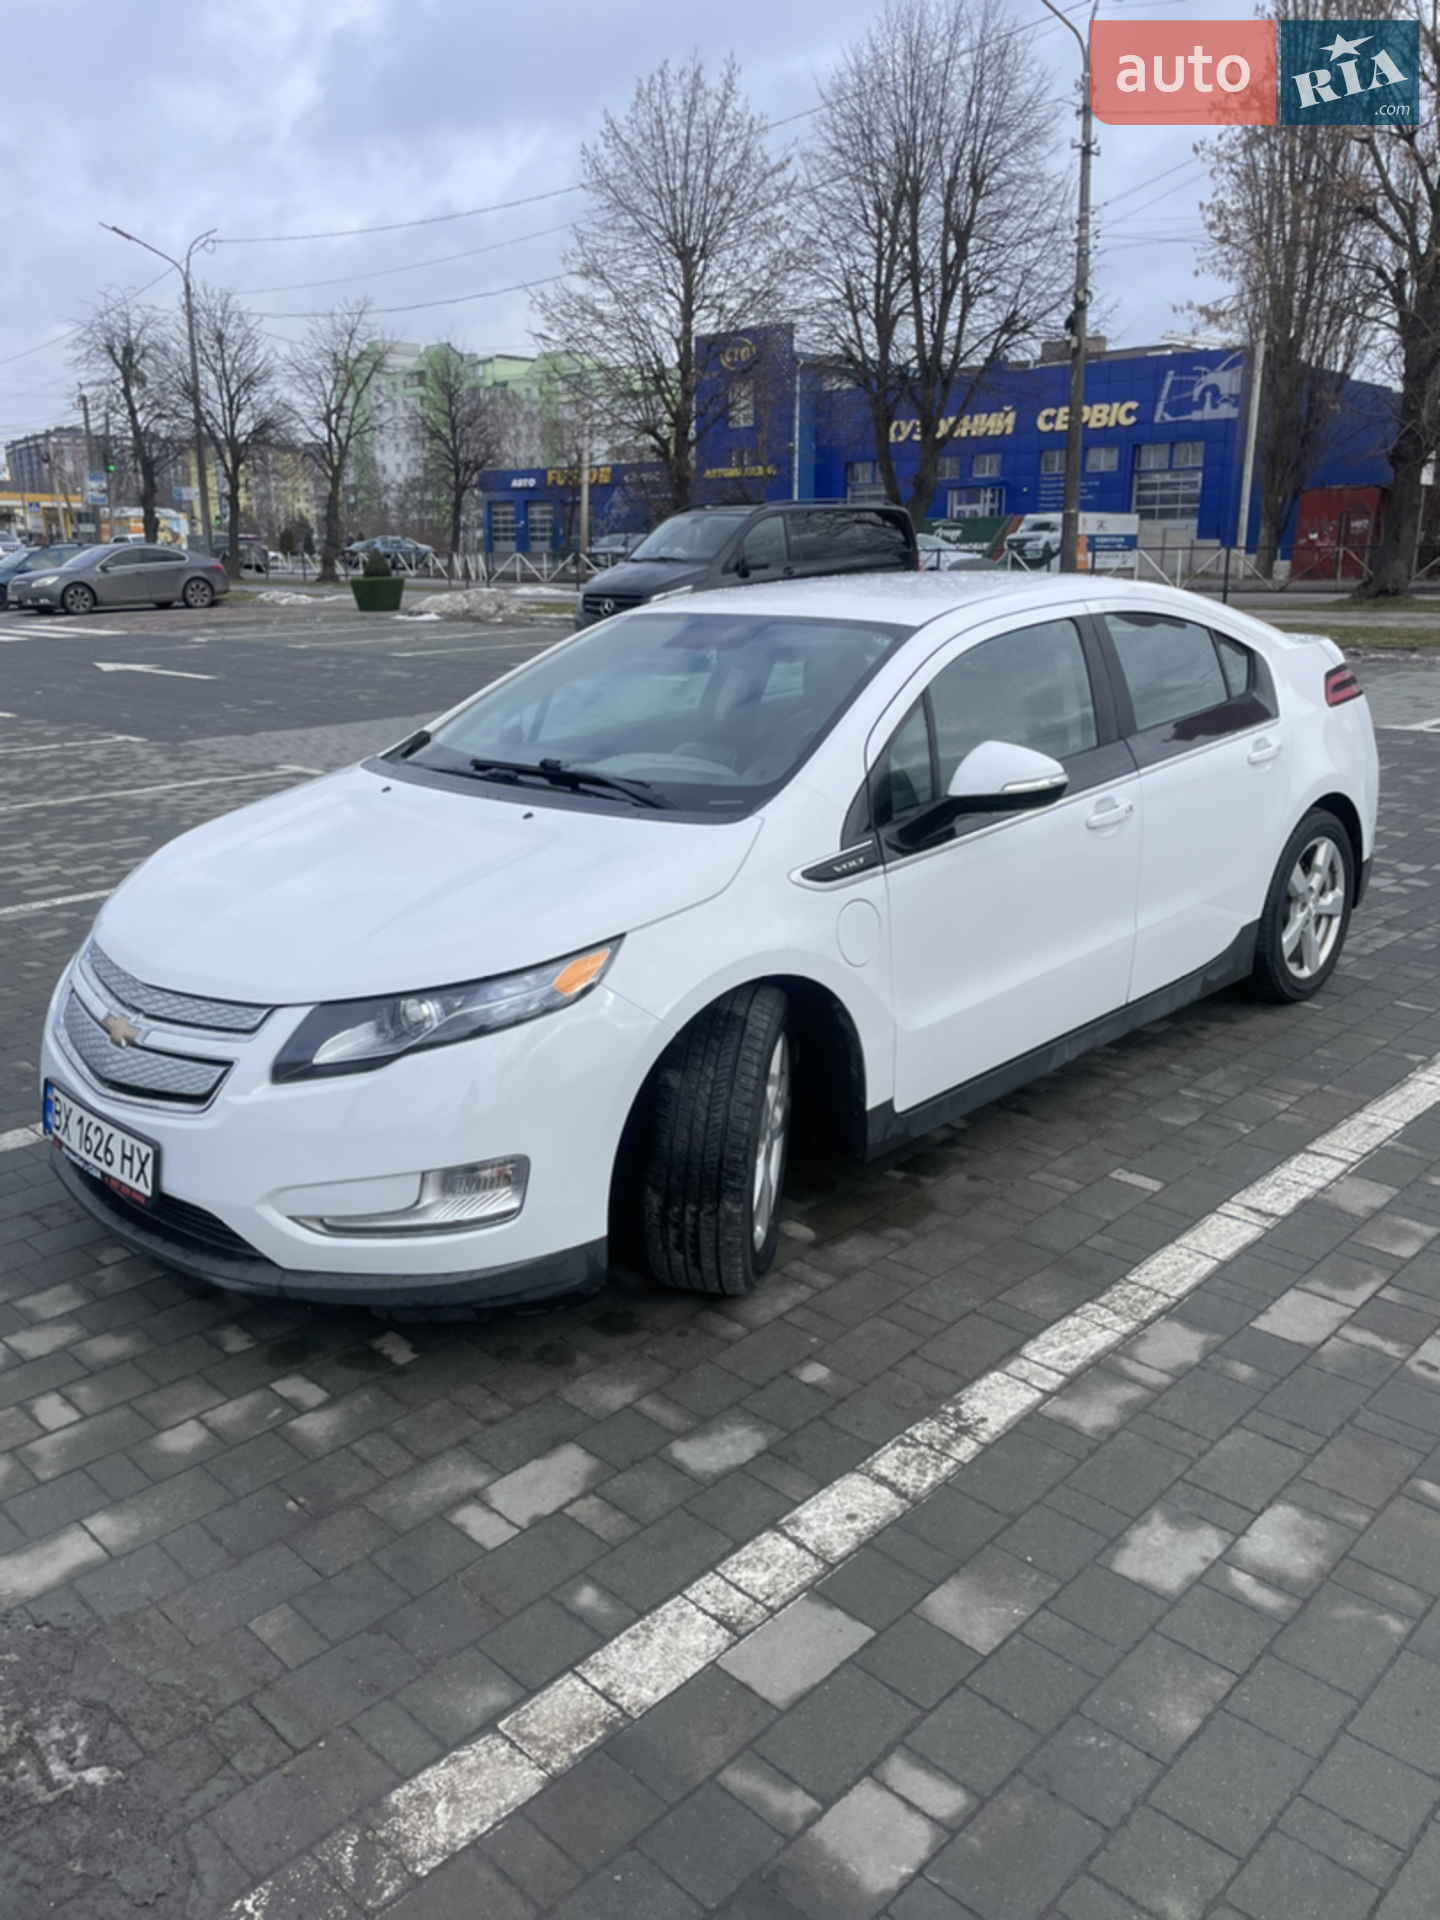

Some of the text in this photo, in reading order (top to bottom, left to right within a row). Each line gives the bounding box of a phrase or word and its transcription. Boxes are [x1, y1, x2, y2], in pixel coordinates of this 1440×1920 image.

[54, 1095, 73, 1143] BX
[77, 1115, 115, 1168] 1626
[120, 1138, 151, 1190] HX
